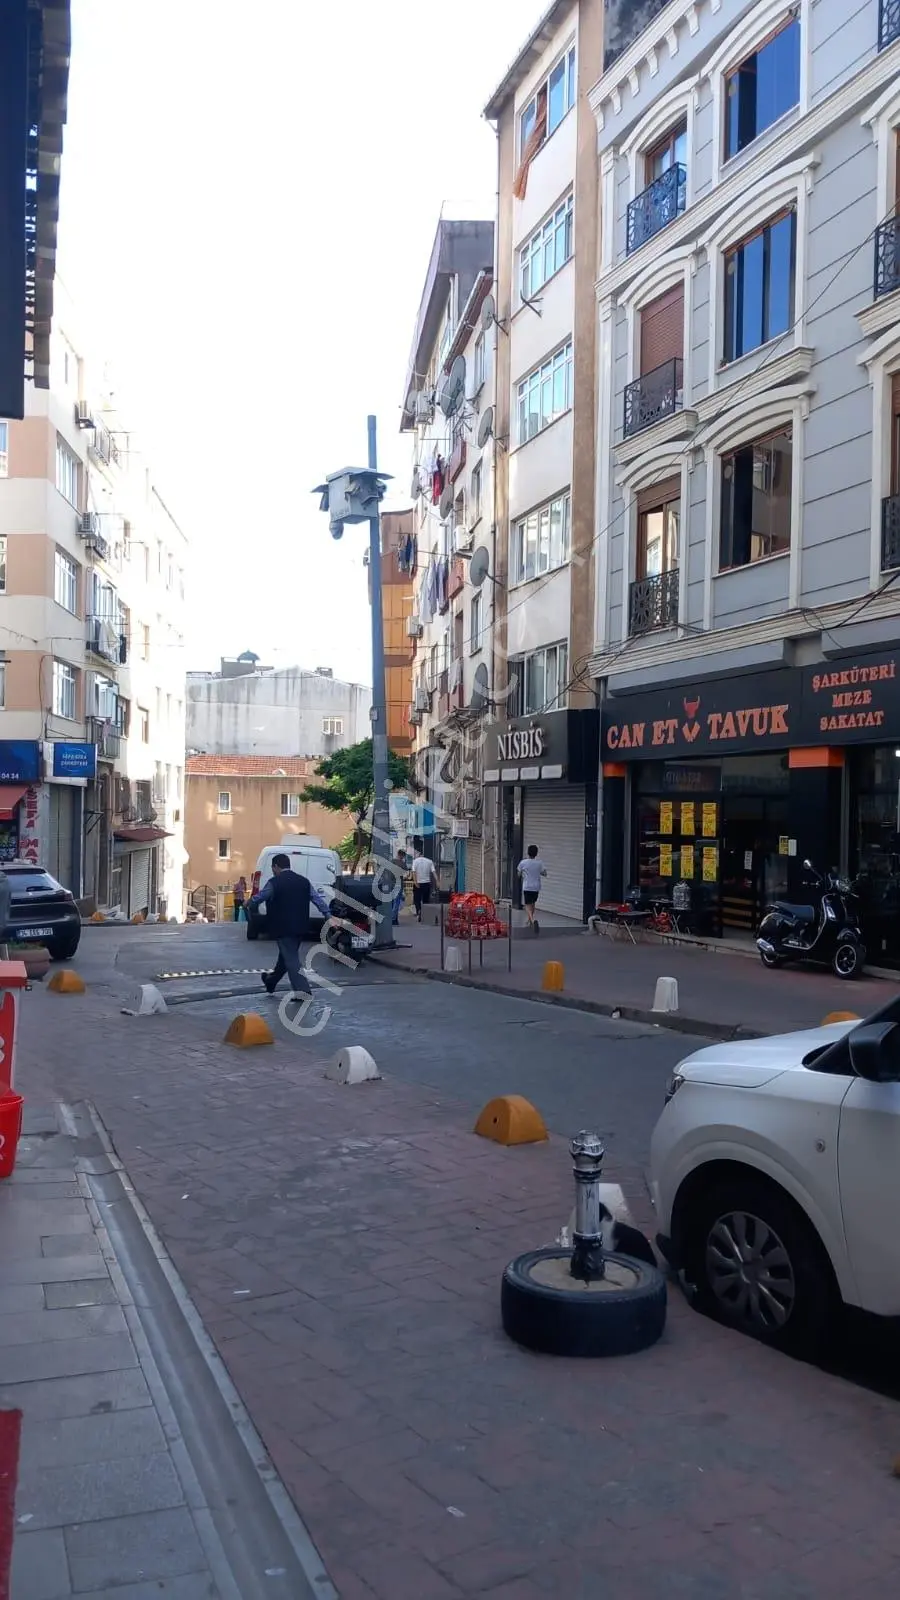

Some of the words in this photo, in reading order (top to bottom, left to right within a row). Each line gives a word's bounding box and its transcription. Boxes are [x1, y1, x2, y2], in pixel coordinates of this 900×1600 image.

[811, 660, 896, 693] ŞARKÜTERİ
[832, 689, 873, 708] MEZE
[606, 723, 645, 750] CAN
[651, 719, 678, 746] ET
[707, 704, 789, 741] TAVUK
[819, 710, 884, 731] SAKATAT
[497, 720, 544, 761] NİSBİS
